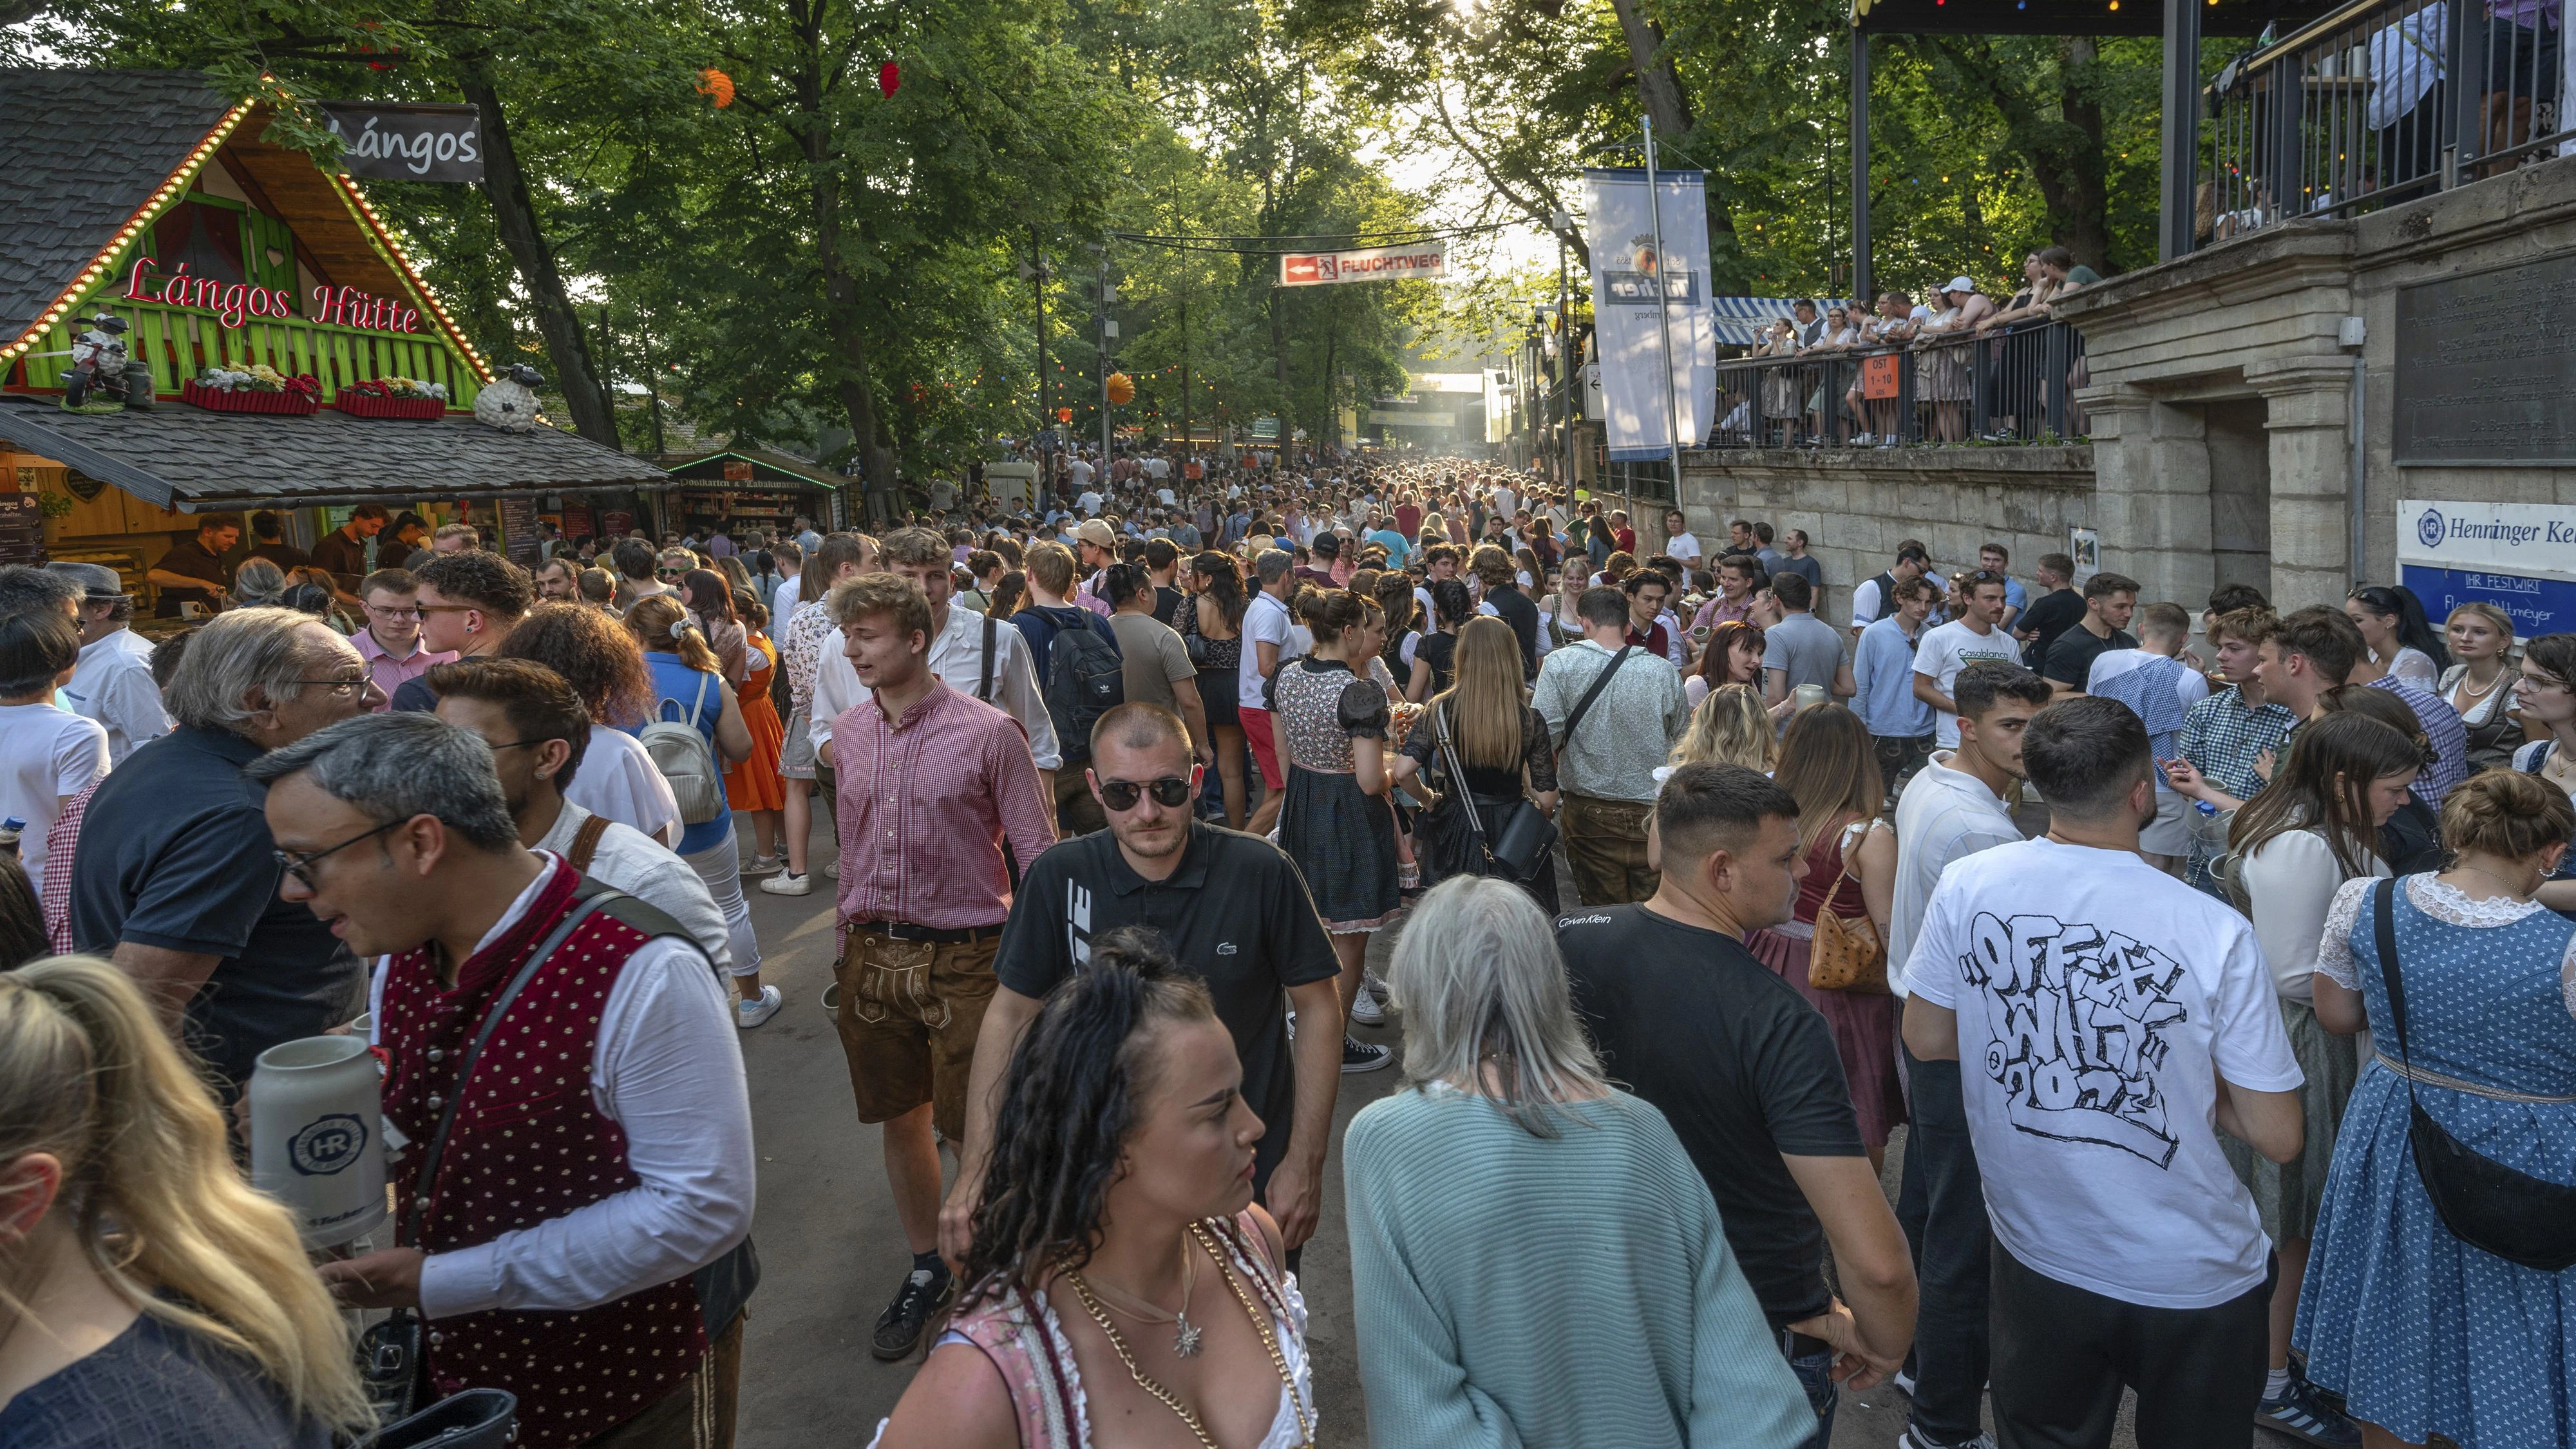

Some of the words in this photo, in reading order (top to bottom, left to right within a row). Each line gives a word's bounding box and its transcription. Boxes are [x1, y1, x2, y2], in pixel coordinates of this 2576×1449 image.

[1341, 253, 1441, 274] FLUCHTWEG
[2493, 273, 2509, 287] Die
[2514, 268, 2543, 283] Keller
[123, 257, 291, 329] Lángos
[306, 285, 420, 334] Hütte
[1873, 358, 1888, 369] OST
[1871, 375, 1875, 385] 1
[1882, 374, 1891, 384] 10
[2470, 419, 2487, 433] Die
[680, 478, 730, 487] Postkarten
[744, 479, 800, 488] Tabakwaren
[2425, 522, 2438, 536] HR
[2449, 518, 2541, 546] Henninger
[2546, 520, 2576, 544] Ke
[2465, 573, 2482, 587] IHR
[2486, 575, 2543, 592] FESTWIRT
[1958, 648, 2009, 659] Casablanca
[1558, 916, 1586, 928] Calvin
[1585, 913, 1611, 924] Klein
[312, 1133, 348, 1158] HR
